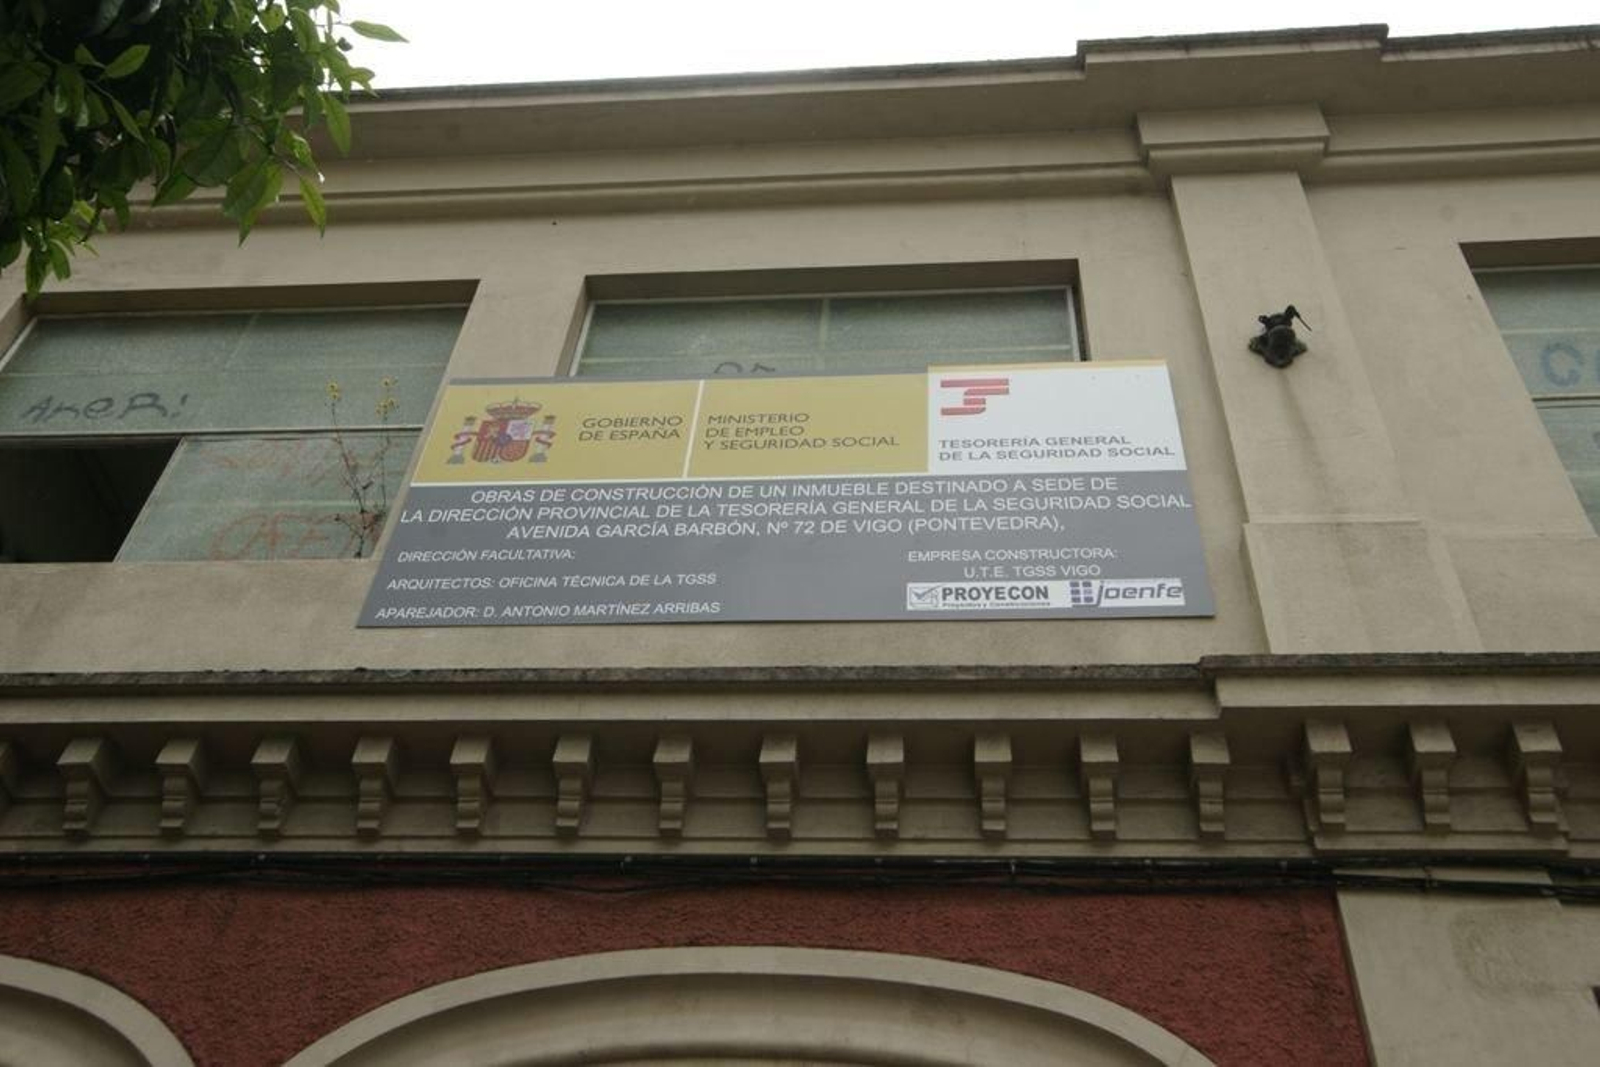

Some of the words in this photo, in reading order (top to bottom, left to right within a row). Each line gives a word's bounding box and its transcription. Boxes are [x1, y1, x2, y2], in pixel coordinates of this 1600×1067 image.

[582, 415, 683, 429] GOBIERNO
[707, 413, 810, 425] MINISTERIO
[578, 430, 604, 441] DE
[609, 427, 681, 441] ESPAÑA
[705, 427, 730, 438] DE
[735, 426, 805, 438] EMPLEO
[704, 440, 714, 450] Y
[720, 438, 827, 450] SEGURIDAD
[831, 436, 900, 448] SOCIAL
[938, 436, 1040, 449] TESORERÍA
[1045, 435, 1131, 447] GENERAL
[939, 451, 962, 461] DE
[968, 450, 992, 460] LA
[996, 448, 1102, 460] SEGURIDAD
[1108, 446, 1175, 457] SOCIAL
[471, 490, 535, 503] OBRAS
[540, 489, 566, 502] DE
[571, 484, 723, 501] CONSTRUCCIÓN
[728, 486, 754, 499] DE
[760, 485, 787, 498] UN
[793, 482, 889, 496] INMUEBLE
[895, 480, 1008, 494] DESTINADO
[1013, 479, 1027, 491] A
[1032, 478, 1085, 491] SEDE
[1091, 477, 1118, 490] DE
[401, 510, 423, 523] LA
[428, 506, 533, 522] DIRECCIÓN
[537, 505, 650, 520] PROVINCIAL
[656, 505, 682, 518] DE
[688, 504, 710, 517] LA
[717, 500, 827, 517] TESORERÍA
[832, 500, 925, 514] GENERAL
[931, 499, 957, 513] DE
[963, 498, 988, 511] LA
[992, 496, 1110, 511] SEGURIDAD
[1116, 494, 1192, 508] SOCIAL
[506, 525, 590, 539] AVENIDA
[596, 521, 670, 538] GARCÍA
[767, 521, 788, 535] Nº
[794, 521, 815, 534] 72
[821, 520, 847, 533] DE
[853, 519, 902, 533] VIGO
[909, 516, 1065, 535] (PONTEVEDRA),
[398, 548, 477, 562] DIRECCIÓN
[481, 549, 576, 560] FACULTATIVA:
[908, 550, 982, 562] EMPRESA
[985, 548, 1117, 560] CONSTRUCTORA:
[964, 565, 1008, 578] U.T.E.
[1012, 565, 1056, 577] TGSS
[1062, 564, 1101, 576] VIGO
[387, 577, 494, 590] ARQUITECTOS:
[499, 576, 557, 588] OFICINA
[563, 574, 625, 588] TÉCNICA
[629, 575, 650, 586] DE
[654, 574, 672, 586] LA
[677, 573, 717, 585] TGSS
[941, 586, 1049, 600] PROYECON
[375, 606, 480, 619] APAREJADOR:
[483, 606, 498, 618] D.
[502, 605, 569, 617] ANTONIO
[573, 600, 650, 616] MARTÍNEZ
[653, 602, 721, 614] ARRIBAS
